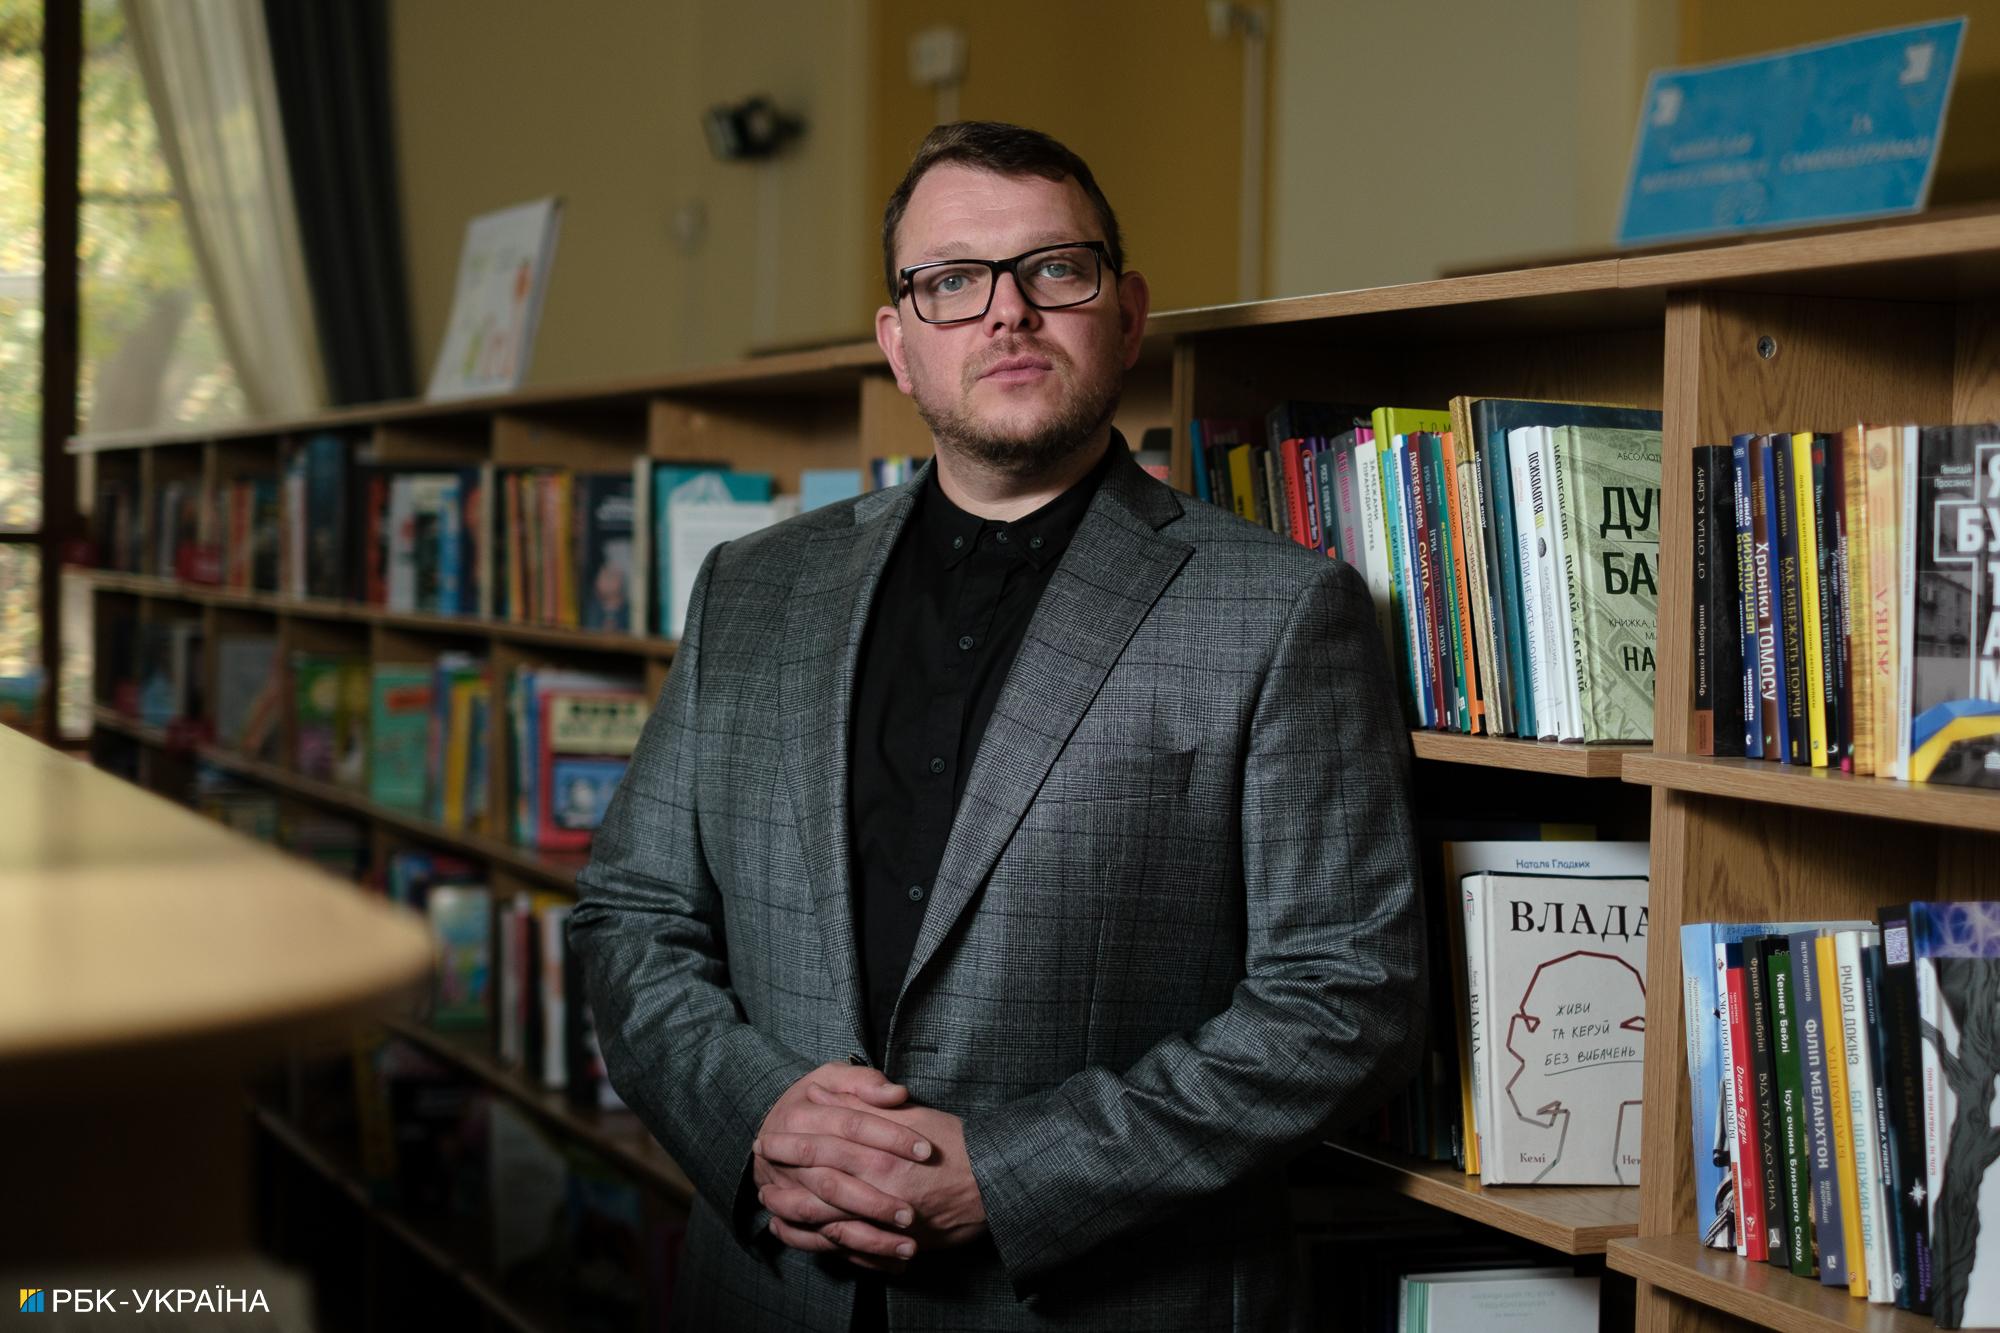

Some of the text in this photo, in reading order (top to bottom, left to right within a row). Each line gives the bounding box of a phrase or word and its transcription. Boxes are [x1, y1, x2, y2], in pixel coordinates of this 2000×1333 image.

[1362, 462, 1370, 511] ПІРАМІДИ
[1370, 459, 1379, 519] ЗА МЕЖАМИ
[1408, 451, 1423, 528] ДЖОЗЕФ МЕРФІ
[1527, 451, 1545, 515] ПСИХОЛОГІЯ
[1777, 450, 1785, 486] ОКСАНА
[1600, 486, 1661, 540] ДУ
[1697, 505, 1704, 513] К
[1518, 532, 1530, 577] НІКОЛИ
[1697, 518, 1705, 555] ОТЦА
[1840, 536, 1849, 571] ЗАГАДКИ
[1418, 541, 1430, 591] СИЛА
[1523, 581, 1531, 594] НЕ
[1602, 551, 1660, 596] БА
[1698, 561, 1705, 578] ОТ
[1741, 532, 1753, 634] ШЕПТИЦЬКИЙ
[1438, 625, 1447, 656] ЛЮДИ
[1608, 618, 1651, 630] КНИЖКА,
[1754, 541, 1776, 700] Хроніки ТОМОСУ
[1784, 556, 1801, 717] КАК ИЗБЕЖАТЬ ПОРЧИ
[1819, 575, 1833, 703] ДОРОГА ПЕРЕМОЖЦІВ
[1874, 587, 1888, 675] ЖИВА
[1697, 604, 1706, 696] Франко Нембрини
[1746, 667, 1754, 720] маринович
[1516, 857, 1591, 871] Наталя Гладких
[1800, 941, 1811, 1001] ПЕТРО КОТЛЯРОВ
[1555, 1001, 1592, 1017] ЖИВИ
[1718, 990, 1727, 1014] ОКА
[1749, 957, 1766, 1052] Франко Нембріні
[1774, 973, 1790, 1053] Кеннет Бейлі
[1839, 965, 1859, 1064] РІЧАРД ДОКІНЗ
[1543, 1045, 1637, 1067] БЕЗ ВИБАЧЕНЬ
[1551, 1018, 1611, 1041] ТА КЕРУЙ
[1720, 1019, 1731, 1072] ТРЕТЬОГО
[1724, 1078, 1736, 1138] ВІДКРИТТЯ
[1735, 1065, 1750, 1144] Дієта Будди
[1804, 1018, 1828, 1167] ФІЛІП МЕЛАНХТОН
[1875, 1087, 1883, 1107] БУРІ
[1519, 1152, 1547, 1166] Кемі
[1758, 1072, 1776, 1210] ВІД ТАТА ДО СИНА
[1853, 1123, 1864, 1146] ЩО
[1784, 1089, 1804, 1262] Ісус очима Близького Сходу
[1855, 1151, 1869, 1209] ВІДЖИВ
[1881, 1144, 1890, 1184] БЕЗПЕКА
